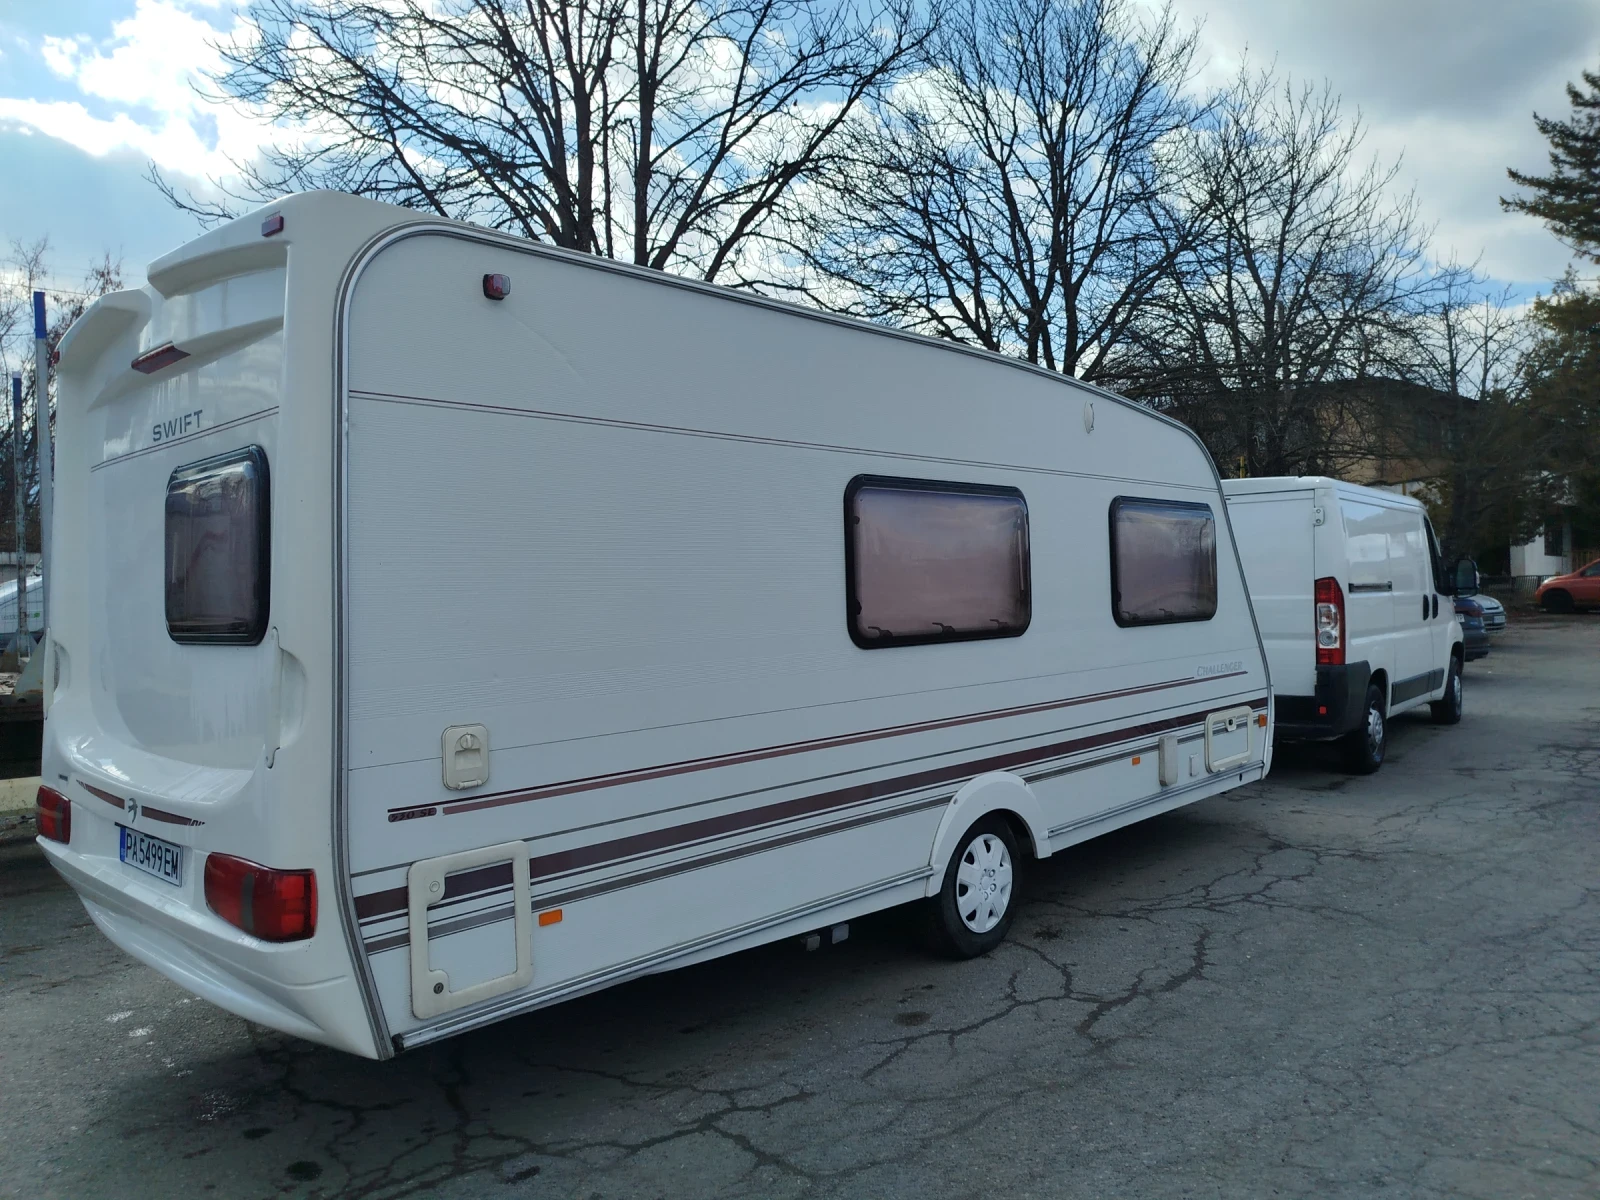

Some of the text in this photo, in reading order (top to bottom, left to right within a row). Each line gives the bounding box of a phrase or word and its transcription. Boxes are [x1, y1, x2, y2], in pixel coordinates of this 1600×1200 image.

[152, 409, 203, 442] SWIFT
[1196, 661, 1243, 677] CHALLENGER
[126, 832, 179, 880] PA5499EM
